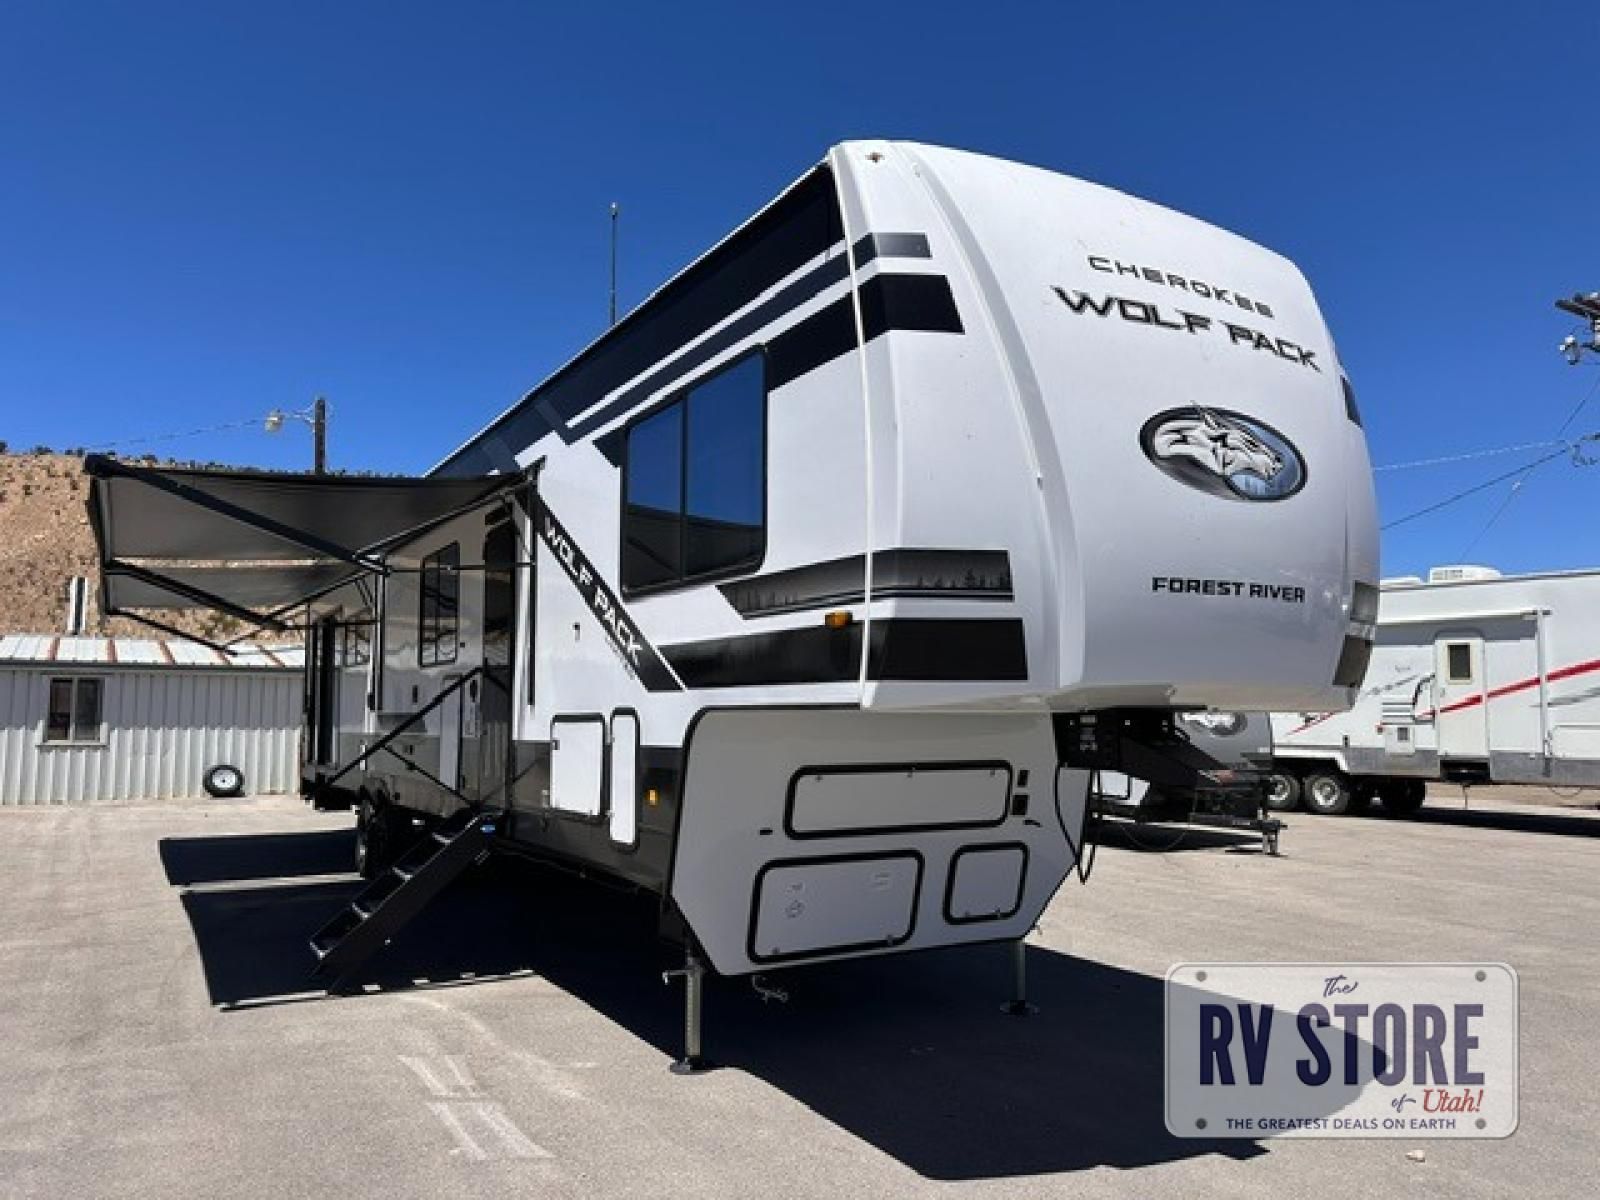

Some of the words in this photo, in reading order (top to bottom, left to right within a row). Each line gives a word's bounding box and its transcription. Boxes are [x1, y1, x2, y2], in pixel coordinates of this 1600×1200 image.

[1088, 255, 1274, 318] CHEROKEE
[1051, 286, 1210, 333] WOLF
[1219, 320, 1321, 372] PACK
[544, 516, 593, 586] WOLF
[595, 584, 643, 667] PACK
[1152, 576, 1245, 596] FOREST
[1249, 584, 1306, 603] RIVER
